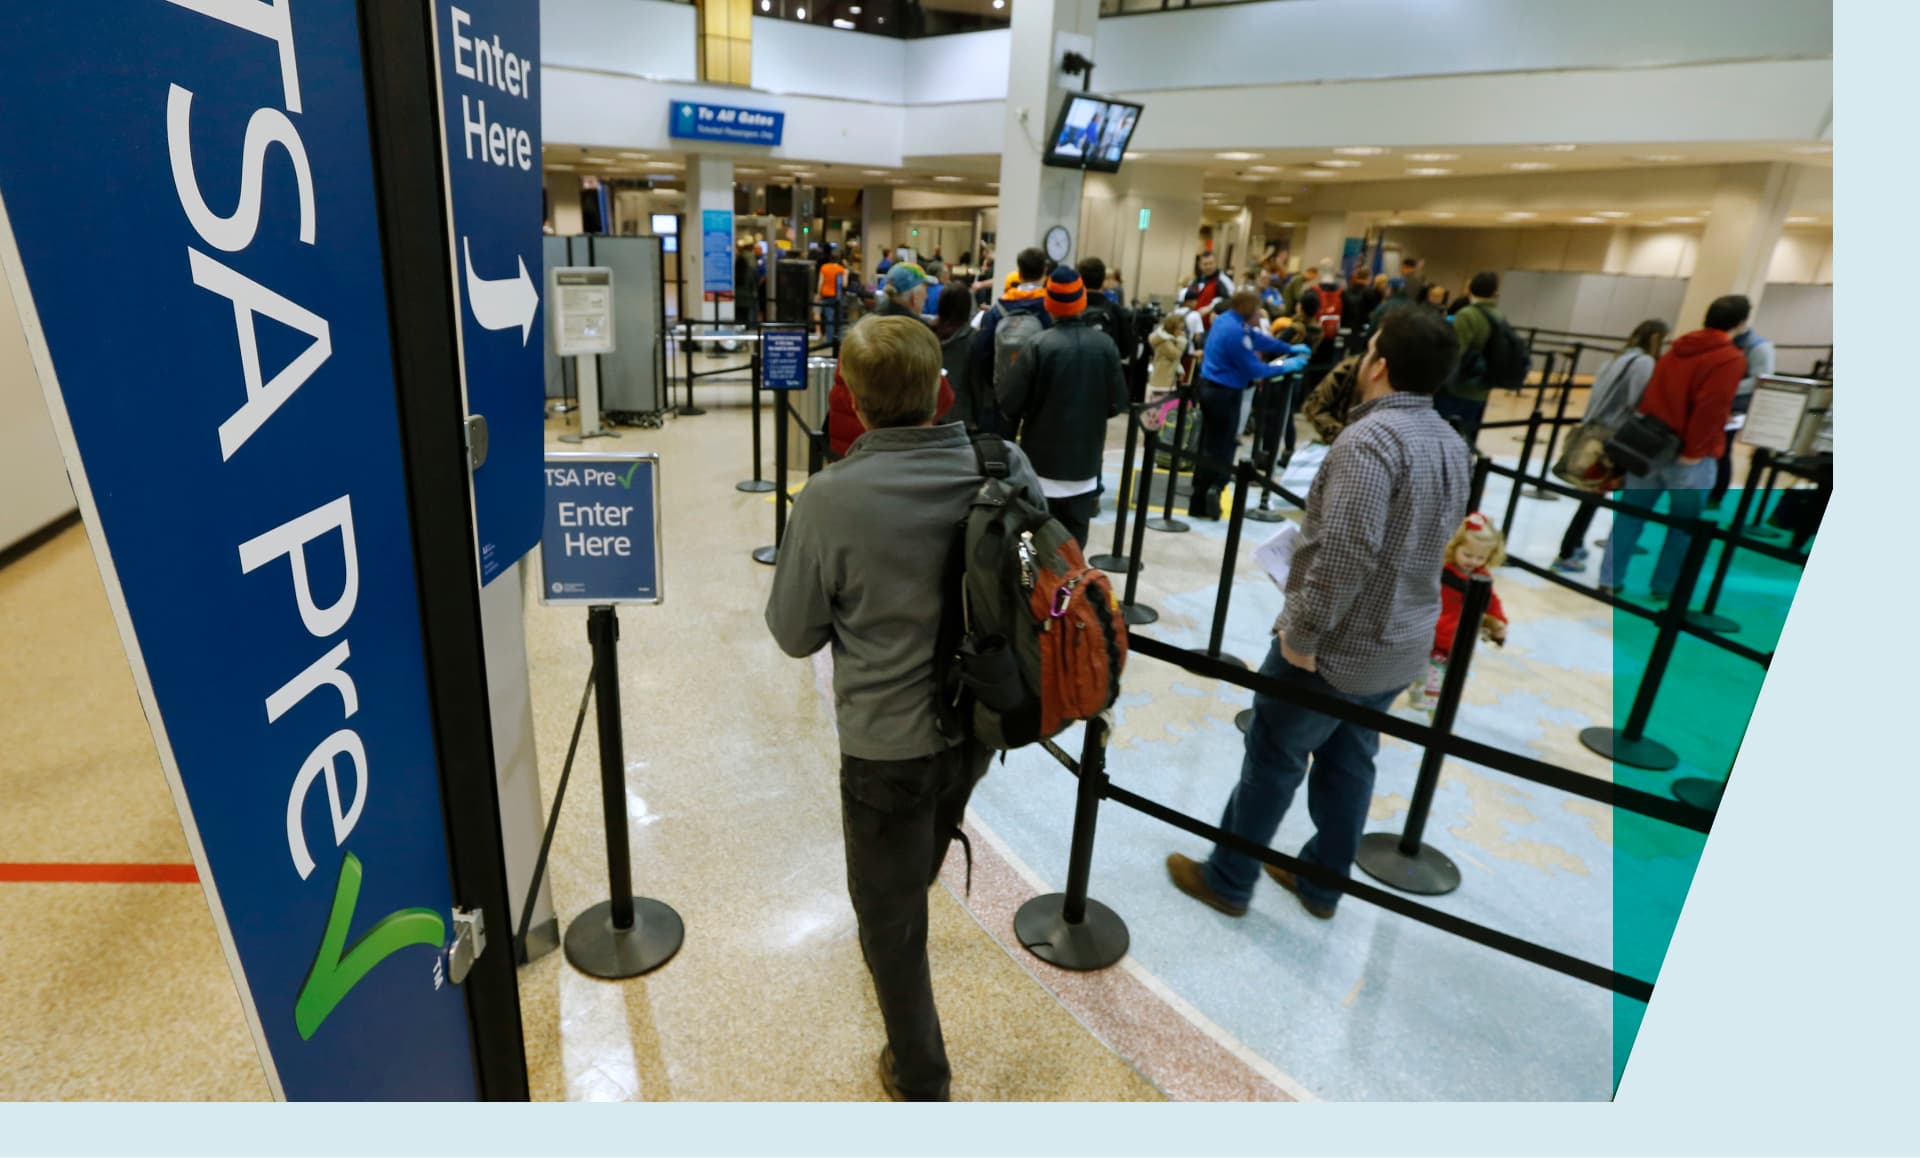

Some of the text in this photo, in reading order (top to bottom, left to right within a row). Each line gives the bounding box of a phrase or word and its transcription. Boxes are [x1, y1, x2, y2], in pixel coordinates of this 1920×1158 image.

[451, 5, 531, 99] Enter
[462, 94, 532, 171] Here
[698, 106, 775, 127] To All Gates
[165, 0, 332, 462] TSA
[544, 468, 616, 487] TSA Pre
[558, 502, 633, 527] Enter
[564, 532, 631, 557] Here
[239, 494, 368, 881] Pre
